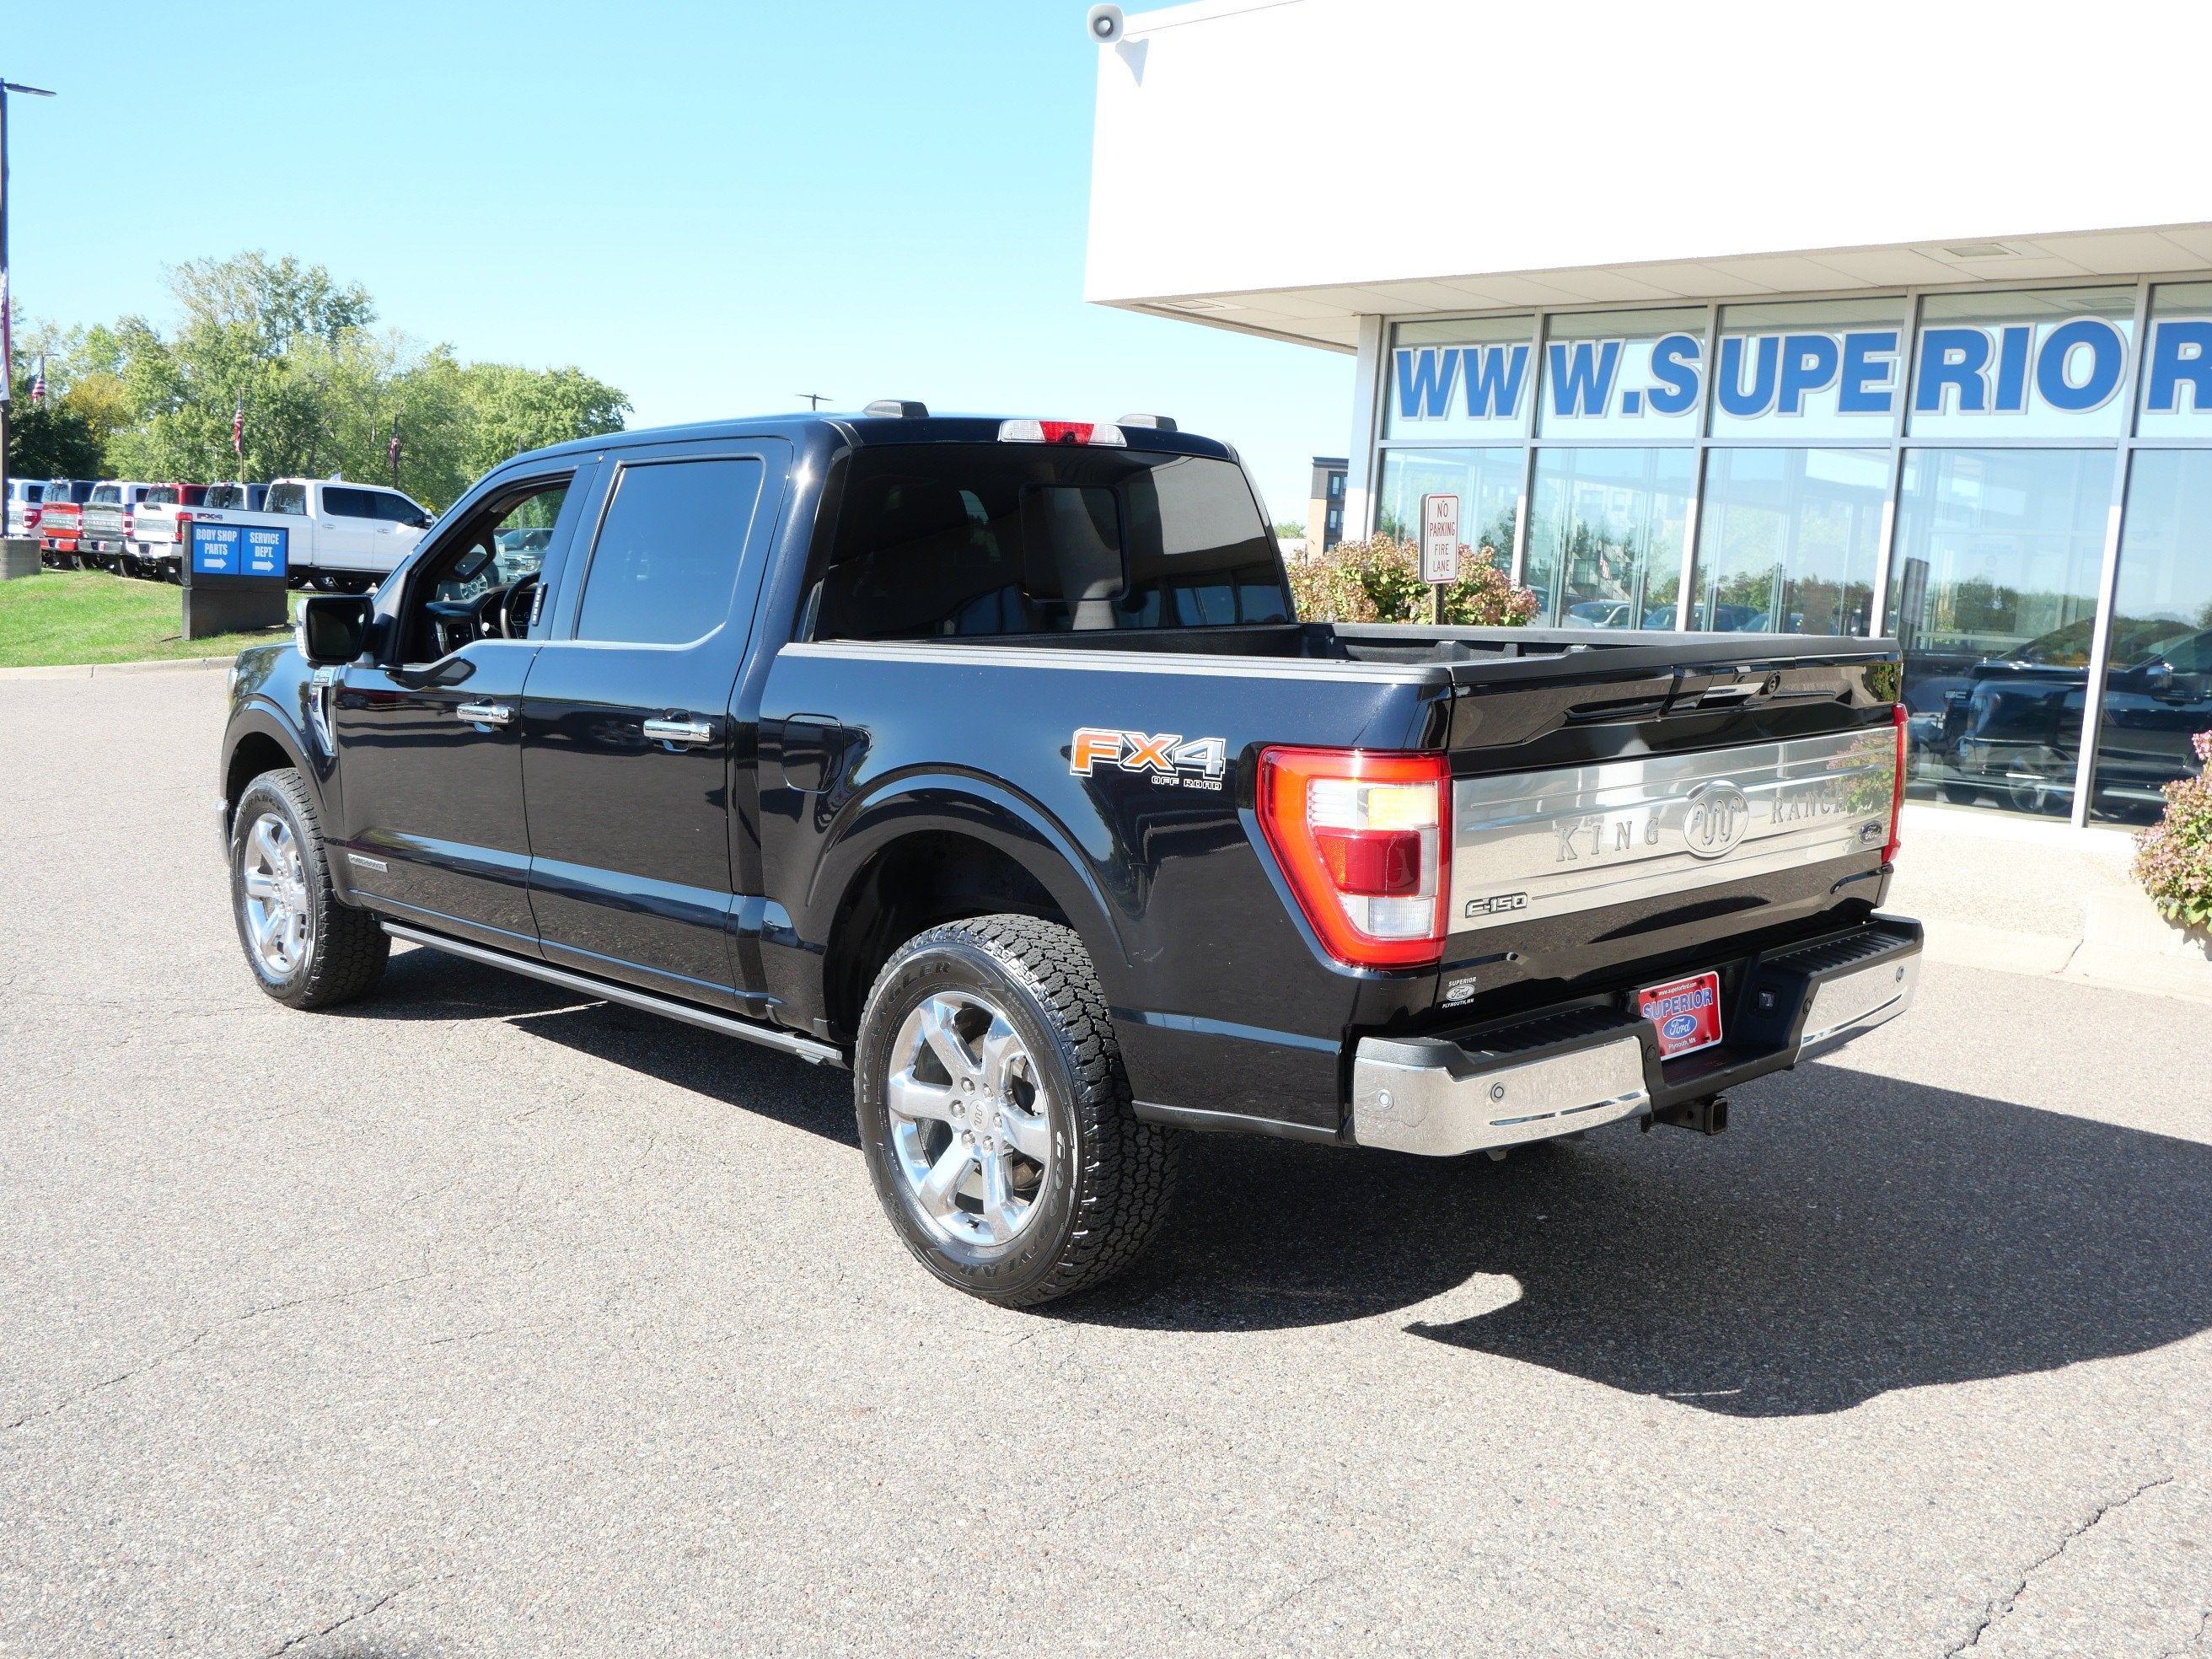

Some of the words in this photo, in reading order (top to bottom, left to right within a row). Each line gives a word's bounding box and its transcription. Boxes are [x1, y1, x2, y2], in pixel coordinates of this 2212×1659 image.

[1436, 502, 1449, 518] NO
[196, 528, 216, 541] BODY
[217, 530, 238, 542] SHOP
[1429, 521, 1456, 537] PARKING
[250, 531, 280, 545] SERVICE
[204, 542, 228, 556] PARTS
[255, 545, 274, 558] DEPT.
[1434, 543, 1449, 556] FIRE
[1433, 559, 1450, 572] LANE
[1069, 727, 1227, 781] FX4
[1151, 775, 1180, 787] OFF
[1183, 777, 1222, 791] ROAD
[1555, 816, 1660, 862] KING
[1770, 784, 1848, 824] RANCH
[1465, 891, 1528, 919] F-150
[1447, 976, 1477, 987] SUPERIOR
[1642, 986, 1714, 1021] SUPERIOR
